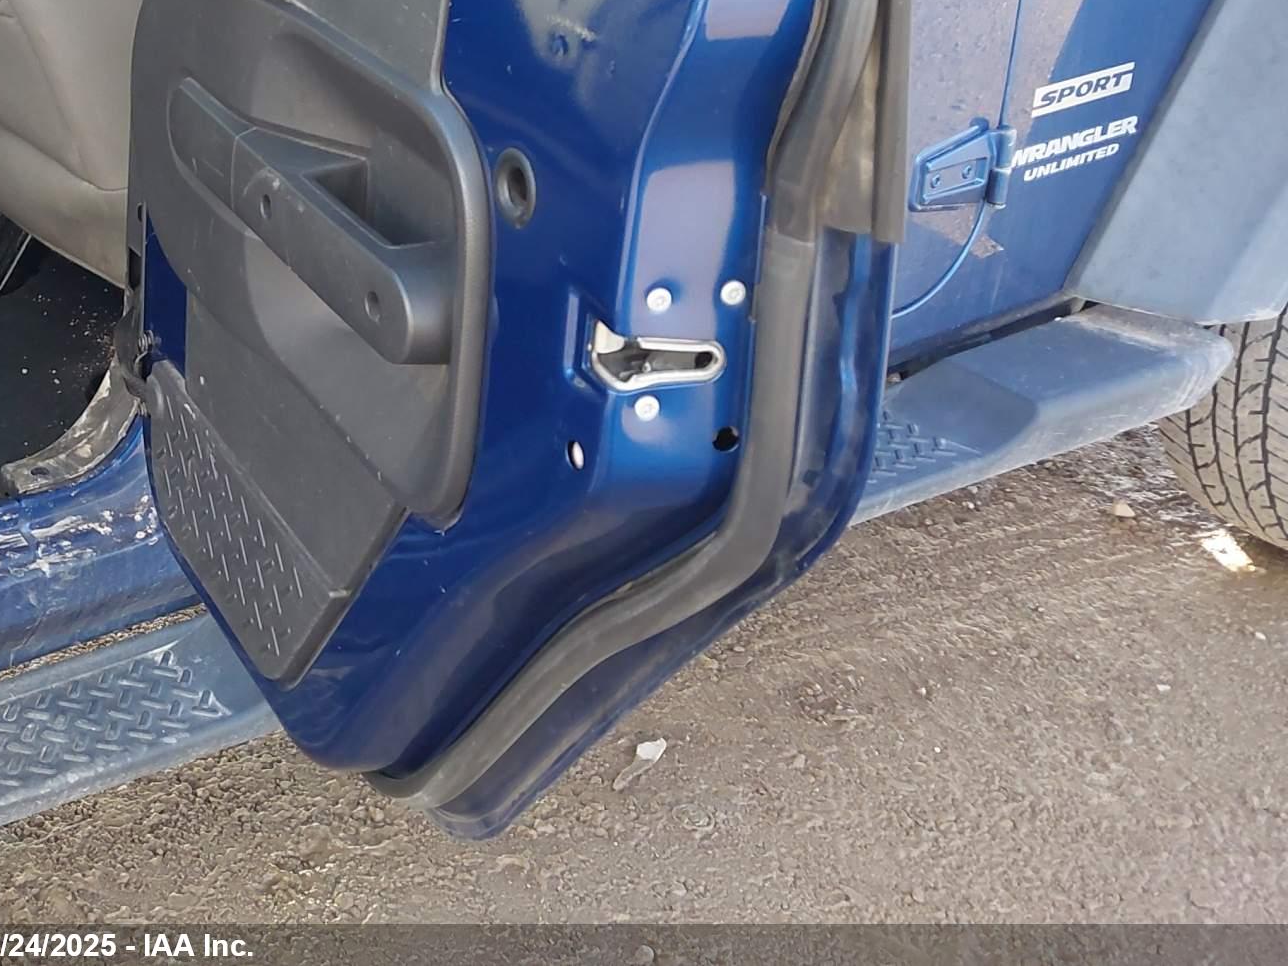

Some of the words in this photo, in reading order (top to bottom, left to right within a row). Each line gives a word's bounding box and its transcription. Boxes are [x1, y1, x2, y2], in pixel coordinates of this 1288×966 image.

[1041, 73, 1125, 107] SPORT
[1012, 115, 1139, 167] WRANGLER
[1024, 143, 1120, 182] UNLIMITED
